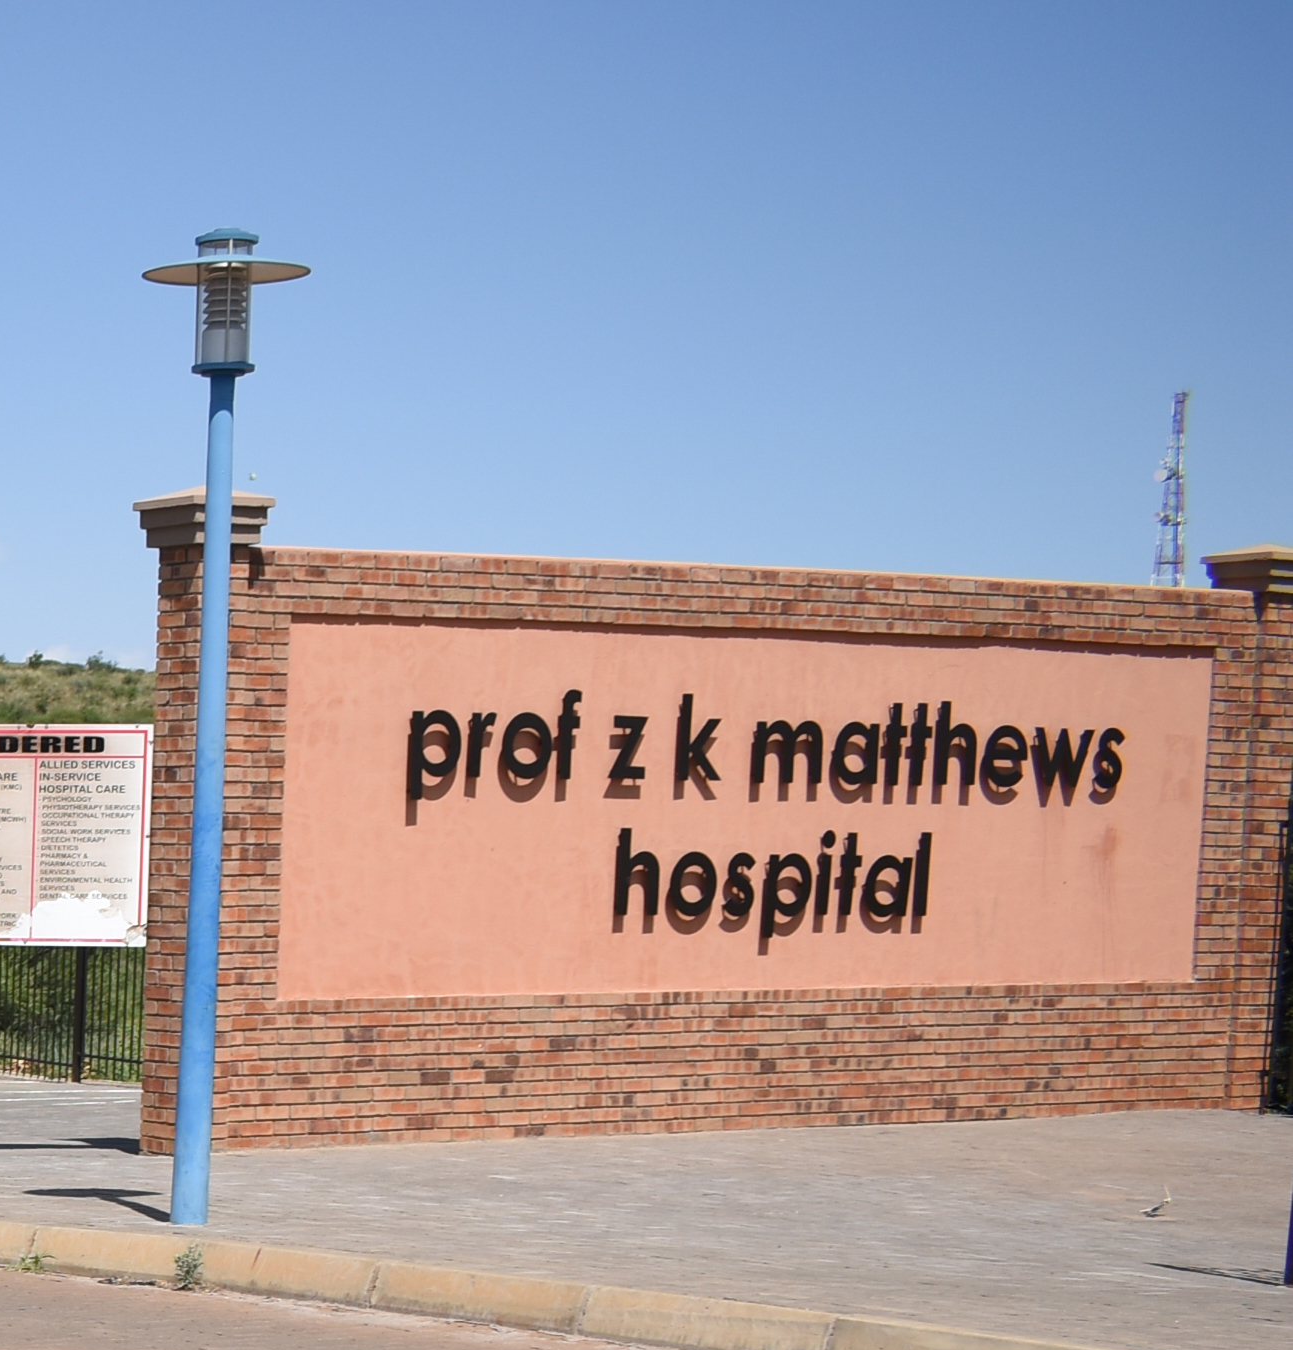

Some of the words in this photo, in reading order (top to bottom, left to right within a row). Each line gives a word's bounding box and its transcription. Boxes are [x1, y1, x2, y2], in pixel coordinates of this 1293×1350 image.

[411, 689, 583, 801] prof
[609, 714, 648, 780] z
[678, 694, 722, 782] k
[751, 700, 1126, 791] matthews
[39, 761, 78, 769] ALLIED
[81, 761, 136, 769] SERVICES
[39, 773, 101, 781] IN-SERVICE
[39, 785, 93, 793] HOSPITAL
[96, 785, 126, 793] CARE
[615, 827, 933, 938] hospital
